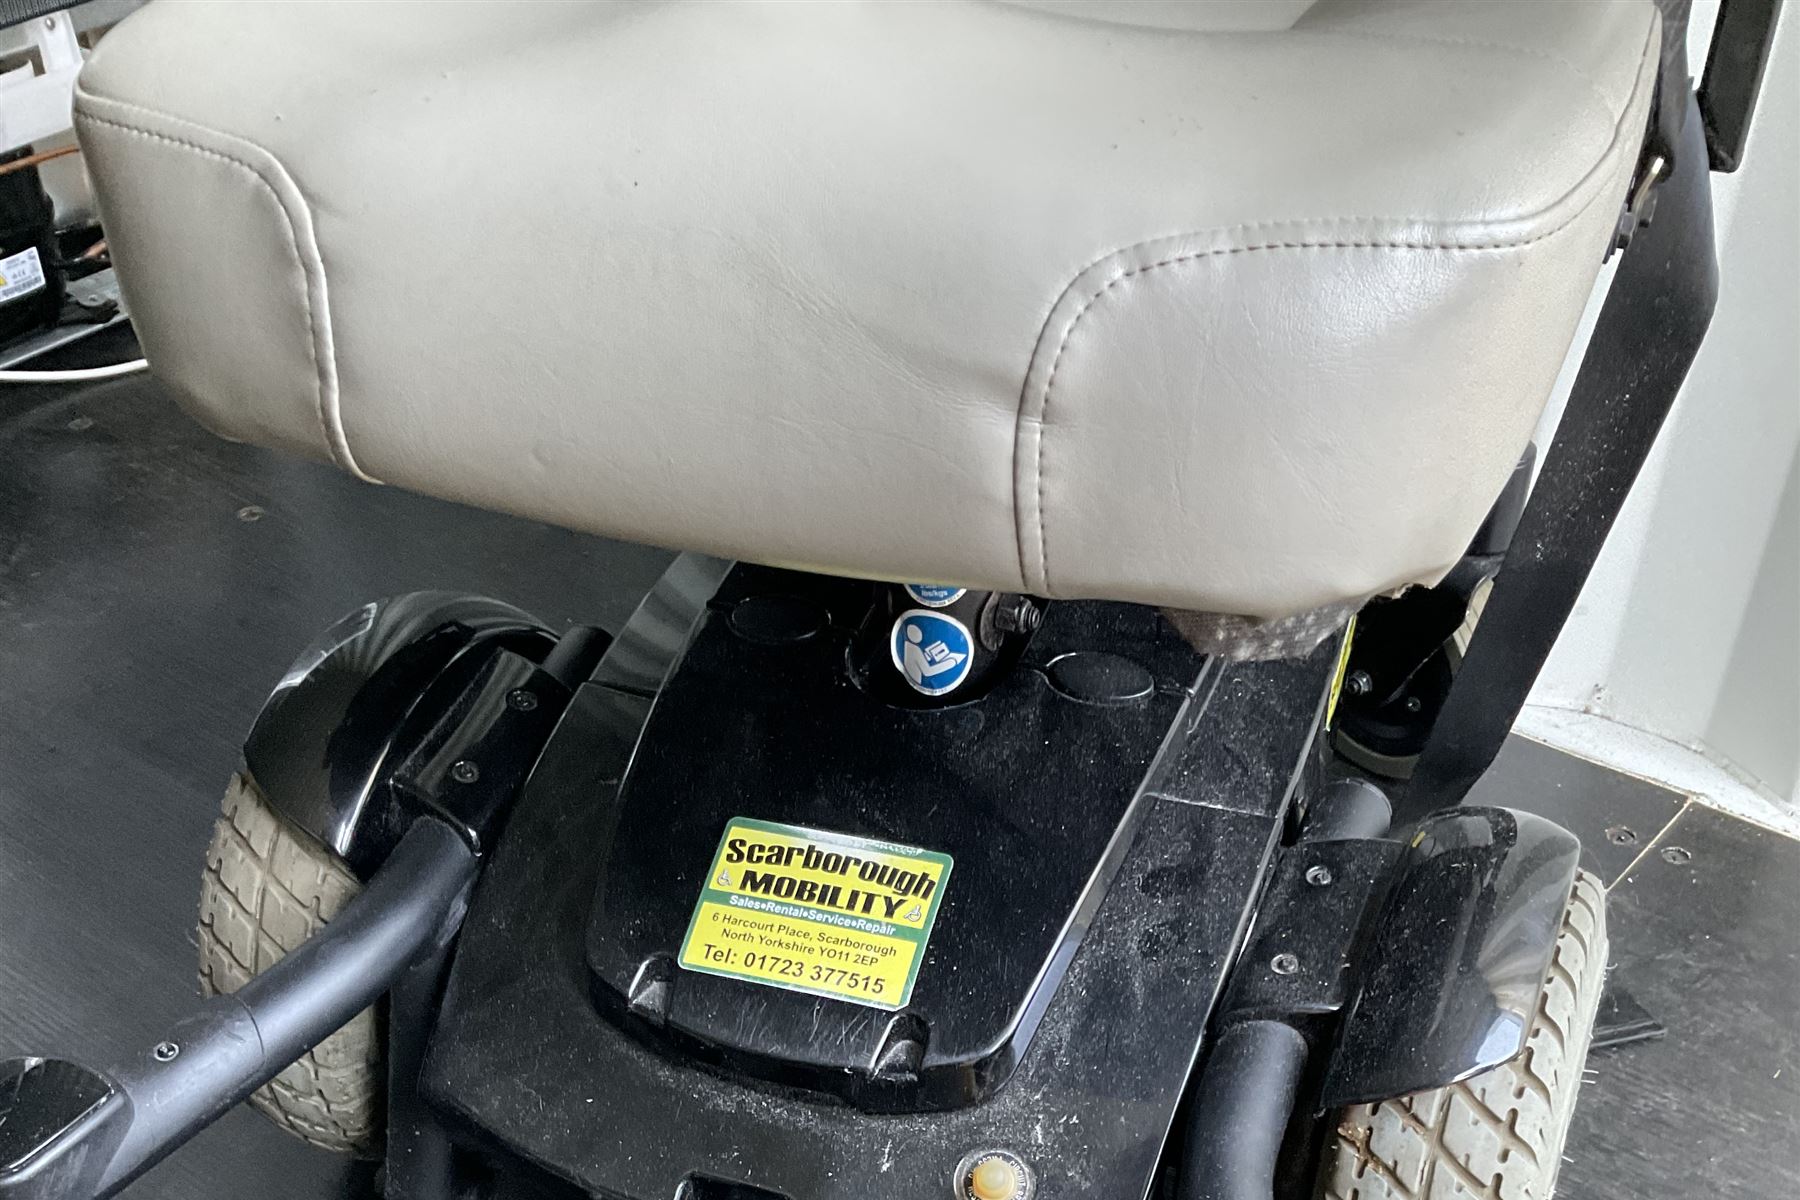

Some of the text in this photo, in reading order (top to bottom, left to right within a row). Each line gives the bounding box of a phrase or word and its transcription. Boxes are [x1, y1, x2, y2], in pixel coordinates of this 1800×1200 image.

[726, 838, 936, 900] Scarborough
[739, 869, 908, 919] MOBILITY
[712, 912, 897, 957] 6 Harcourt Place, Scarborough
[721, 928, 879, 967] North Yorkshire YO11 2EP
[703, 944, 886, 994] Tel: 01723 377515
